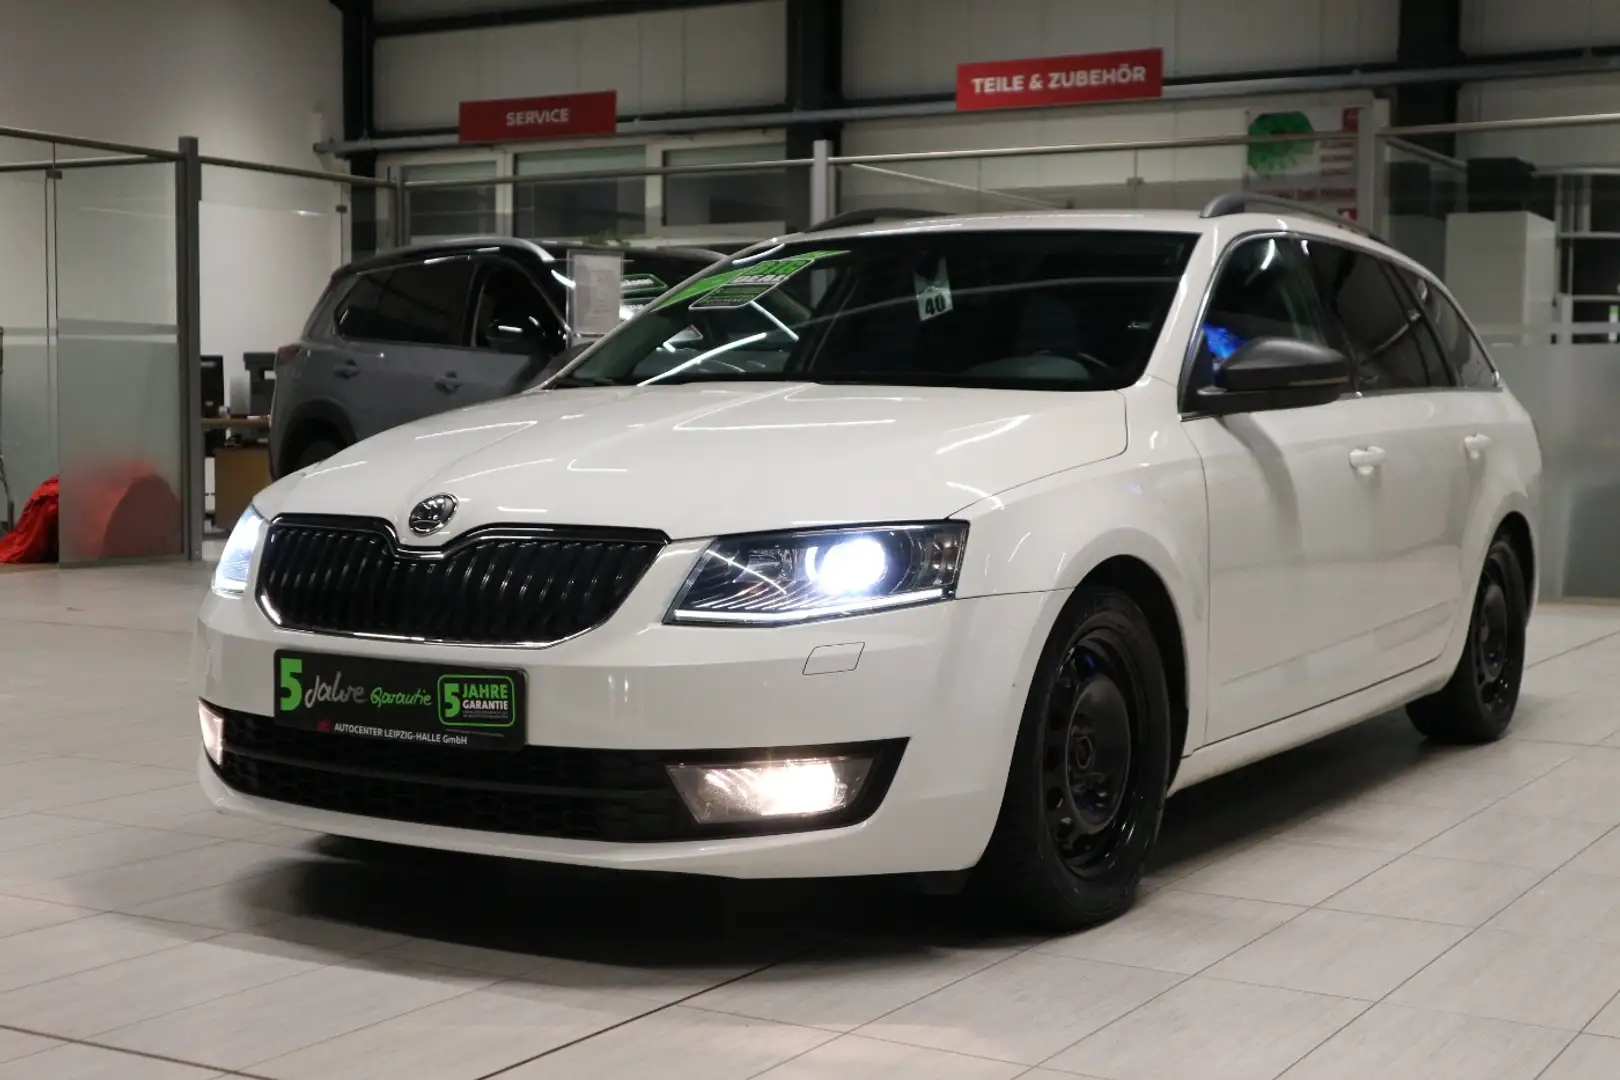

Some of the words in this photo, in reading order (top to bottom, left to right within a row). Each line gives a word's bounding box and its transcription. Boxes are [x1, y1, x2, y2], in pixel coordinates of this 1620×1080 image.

[971, 75, 1024, 95] TEILE
[1028, 73, 1044, 91] &
[1047, 63, 1147, 88] ZUBEHÖR
[506, 108, 570, 127] SERVICE
[925, 293, 946, 315] 40
[280, 658, 302, 711] 5
[444, 682, 461, 718] 5
[462, 684, 509, 699] JAHRE
[462, 700, 509, 710] GARANTIE
[334, 722, 384, 738] AUTOCENTER
[384, 729, 441, 744] LEIPZIG-HALLE
[442, 735, 468, 745] GmbH
